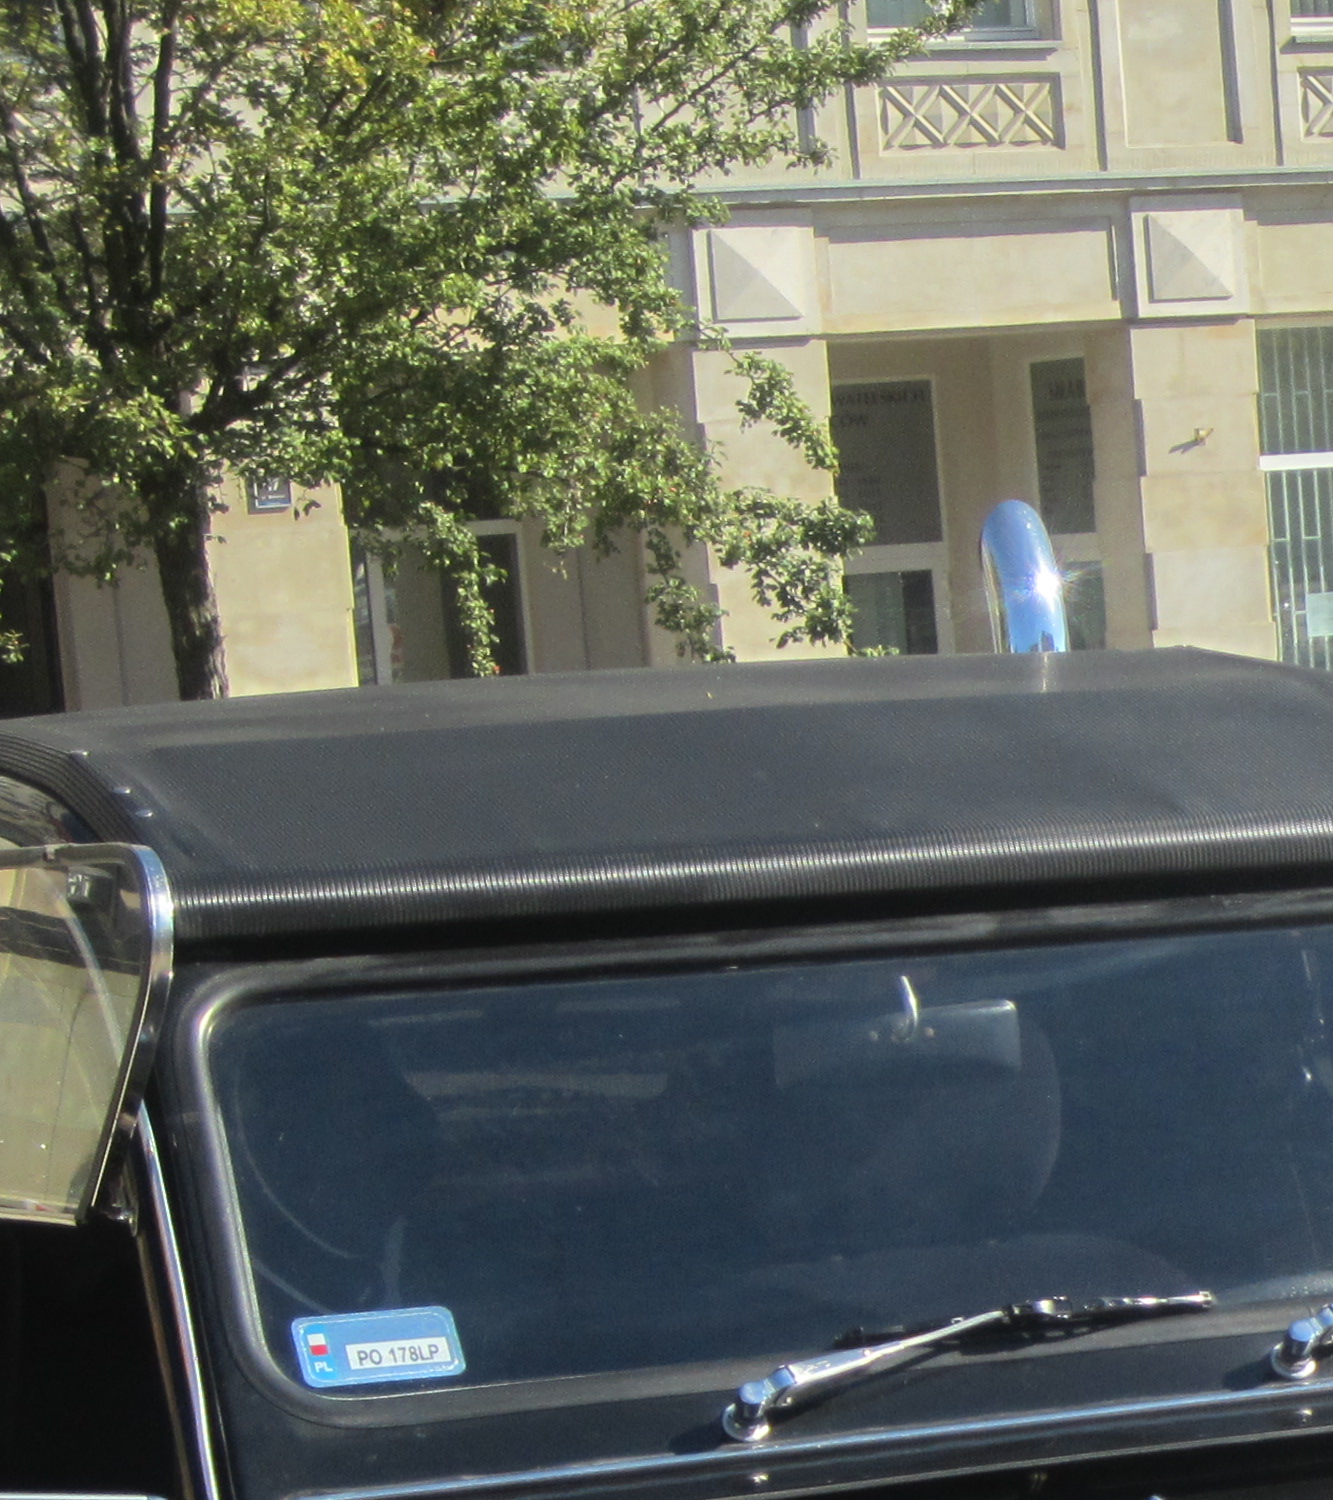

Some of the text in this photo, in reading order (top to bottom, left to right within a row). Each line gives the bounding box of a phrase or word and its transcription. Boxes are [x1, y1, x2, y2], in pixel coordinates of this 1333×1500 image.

[356, 1343, 440, 1367] PO 178LP
[314, 1361, 334, 1373] PL
